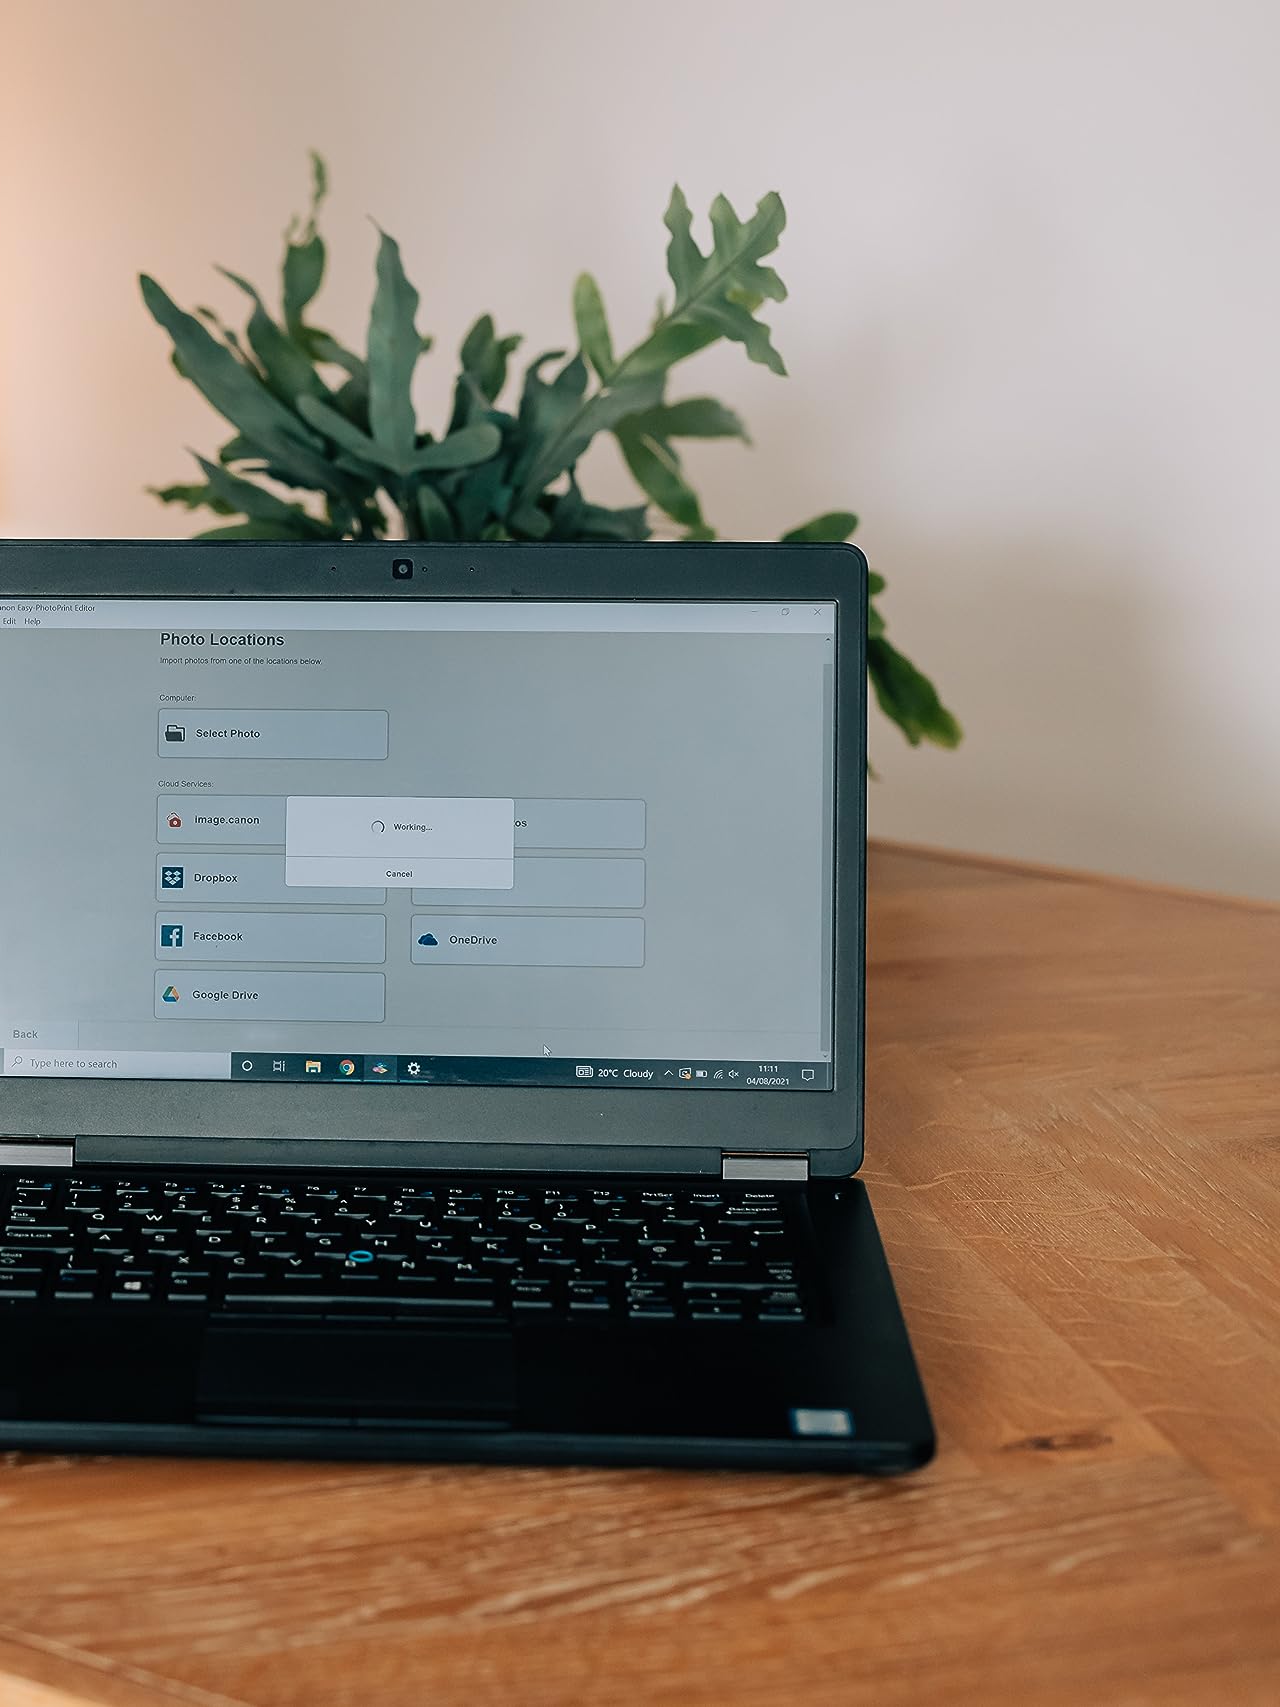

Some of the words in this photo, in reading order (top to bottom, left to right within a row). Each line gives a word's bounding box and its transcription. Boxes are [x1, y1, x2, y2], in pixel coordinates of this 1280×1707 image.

[18, 604, 72, 613] Easy-PhotoPrint
[75, 604, 95, 612] Editor
[25, 618, 41, 626] Help
[161, 633, 205, 646] Photo
[210, 633, 285, 646] Locations
[160, 657, 182, 665] Import
[185, 657, 208, 665] photos
[159, 693, 197, 703] Computer:
[195, 728, 228, 739] Select
[230, 728, 261, 739] Photo
[158, 780, 179, 789] Cloud
[181, 780, 214, 789] Services:
[194, 815, 260, 827] image.canon
[393, 822, 433, 833] Working...
[193, 872, 238, 885] Dropbox
[385, 869, 413, 879] Cancel
[193, 931, 244, 942] Facebook
[449, 934, 498, 946] OneDrive
[192, 990, 229, 1002] Google
[232, 990, 259, 1001] Drive
[13, 1029, 38, 1040] Back
[30, 1058, 51, 1070] Type
[54, 1059, 73, 1070] here
[75, 1059, 85, 1070] to
[87, 1059, 118, 1070] search
[758, 1065, 778, 1073] 11:11
[623, 1069, 654, 1080] Cloudy
[122, 1255, 135, 1263] Z
[178, 1256, 190, 1264] X
[402, 1261, 415, 1269] N
